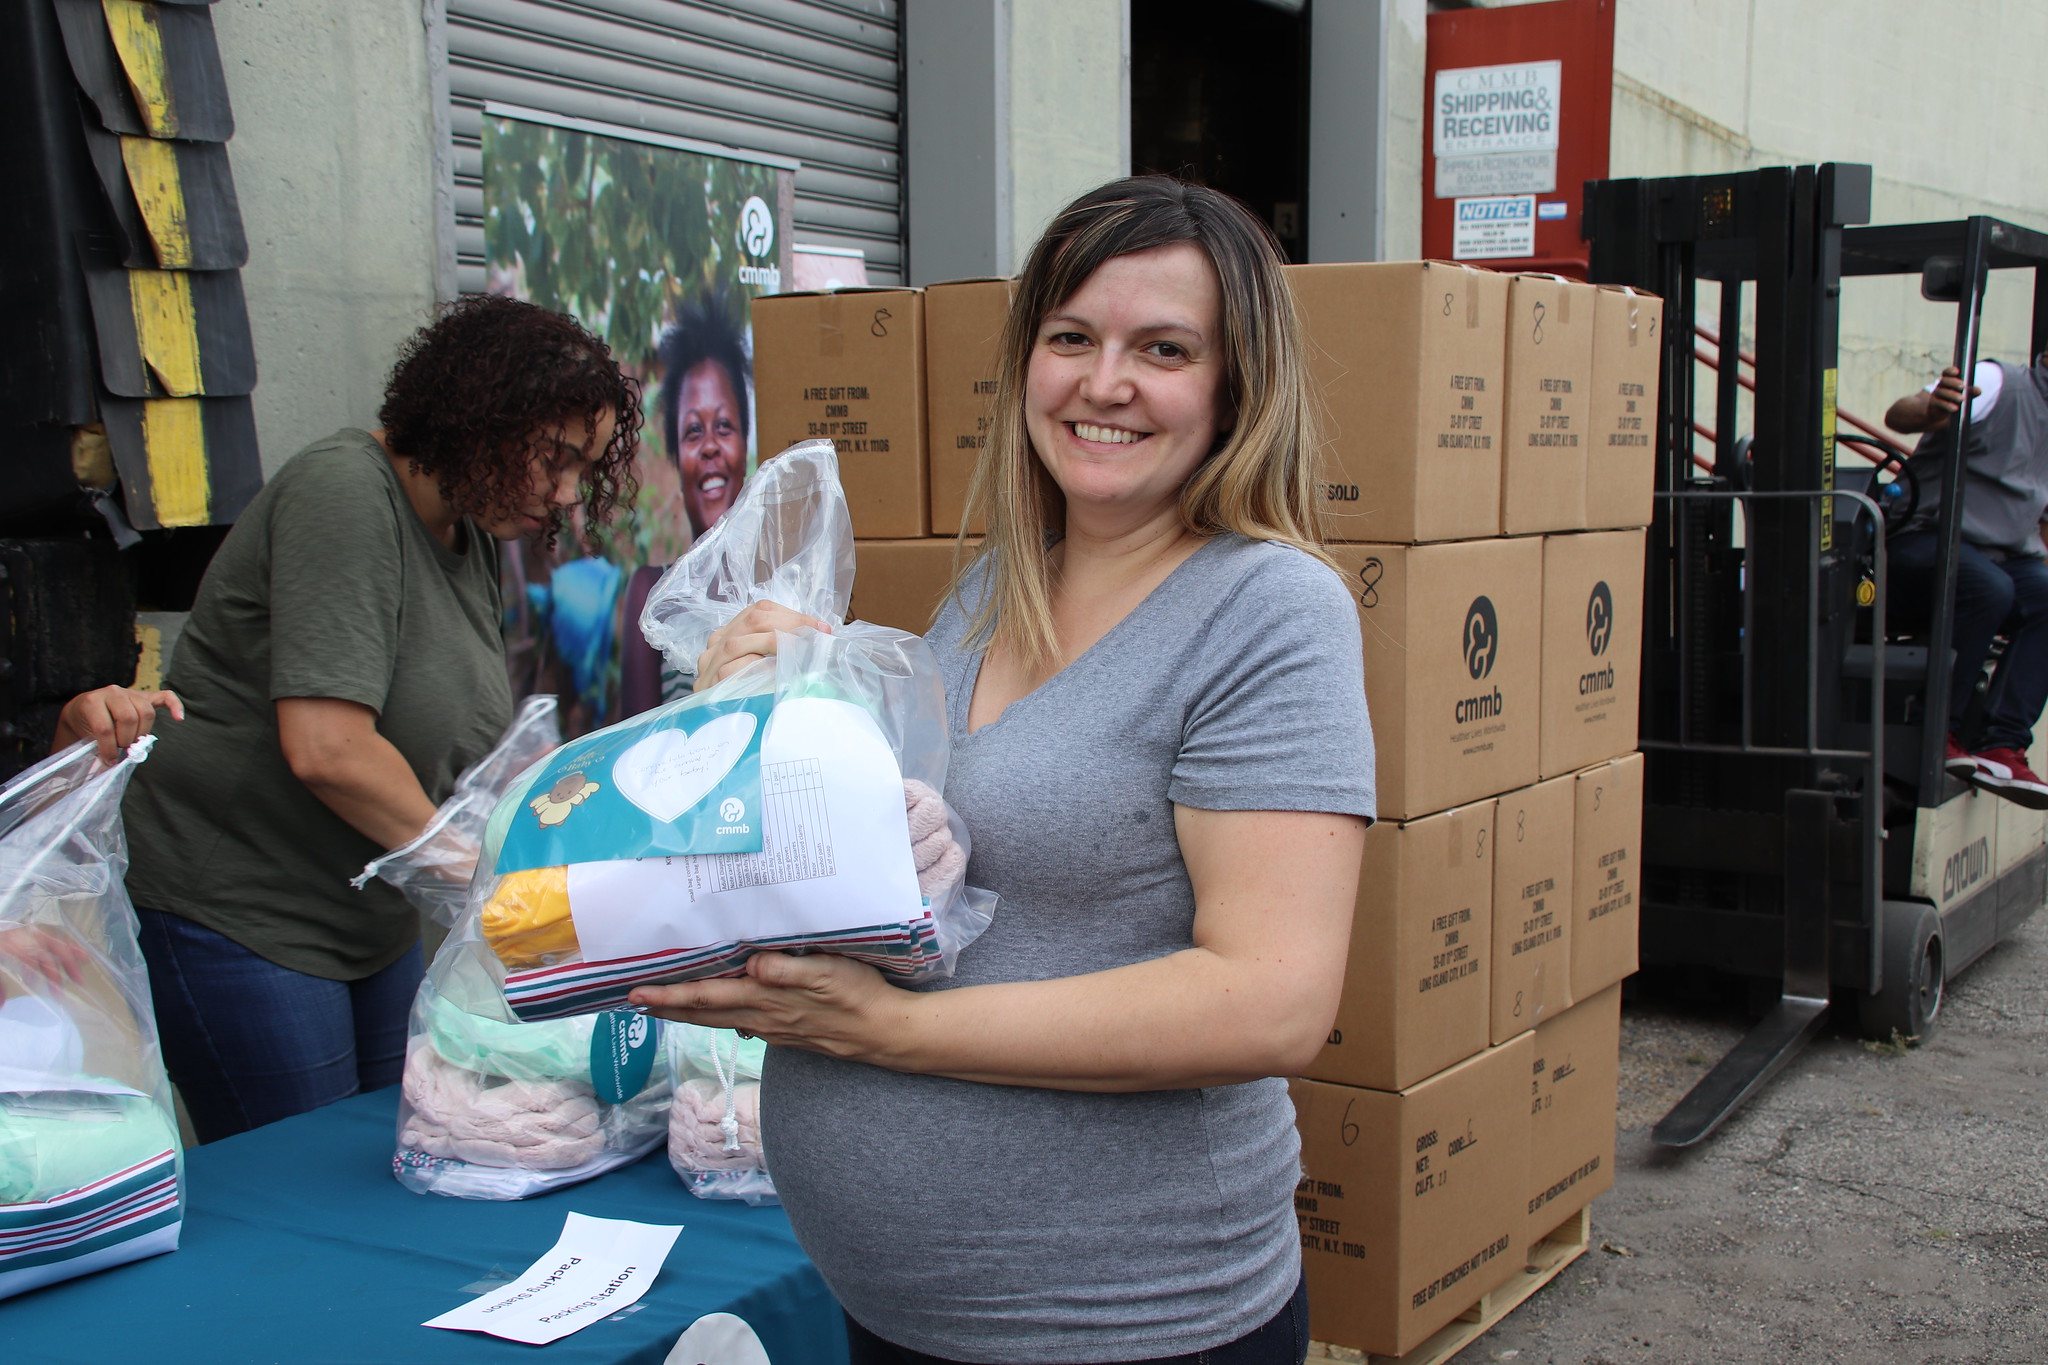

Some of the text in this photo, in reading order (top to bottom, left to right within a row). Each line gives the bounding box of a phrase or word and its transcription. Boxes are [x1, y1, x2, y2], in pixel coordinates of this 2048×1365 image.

[1441, 89, 1534, 115] SHIPPING
[1443, 112, 1550, 139] RECEIVING
[1460, 201, 1529, 219] NOTICE
[738, 263, 781, 286] cmmb
[1442, 293, 1454, 316] 8
[870, 307, 892, 338] 8
[1533, 301, 1546, 345] 8
[804, 386, 869, 400] A FREE GIFT FROM:
[974, 381, 978, 394] A
[825, 404, 848, 417] CMMB
[841, 422, 868, 435] STREET
[854, 439, 869, 452] N.Y.
[870, 439, 890, 452] 11106
[956, 434, 976, 449] LONG
[1327, 484, 1360, 501] SOLD
[1359, 556, 1384, 608] 8
[1579, 660, 1614, 696] cmmb
[1455, 684, 1502, 725] cmmb
[715, 823, 750, 835] cmmb
[1516, 809, 1526, 842] 8
[1475, 828, 1486, 859] 8
[1436, 914, 1447, 931] FREE
[1448, 912, 1459, 928] GIFT
[1540, 912, 1554, 928] STREET
[1453, 944, 1469, 963] STREET
[1419, 975, 1432, 993] LONG
[1432, 970, 1449, 988] ISLAND
[618, 1020, 630, 1066] cmmb
[1327, 1029, 1343, 1045] LD
[1341, 1097, 1360, 1147] 6
[1416, 1129, 1439, 1154] GROSS:
[1416, 1155, 1430, 1175] NET:
[1317, 1180, 1345, 1199] FROM:
[1535, 1192, 1545, 1210] GIFT
[1589, 1155, 1600, 1174] SOLD
[1309, 1216, 1341, 1236] STREET
[1301, 1233, 1366, 1260] CITY, N.Y. 11106
[1412, 1233, 1510, 1311] FREE GIFT MEDICINES NOT TO BE SOLD
[482, 1256, 582, 1314] Packing Station
[538, 1265, 637, 1326] Packing Station
